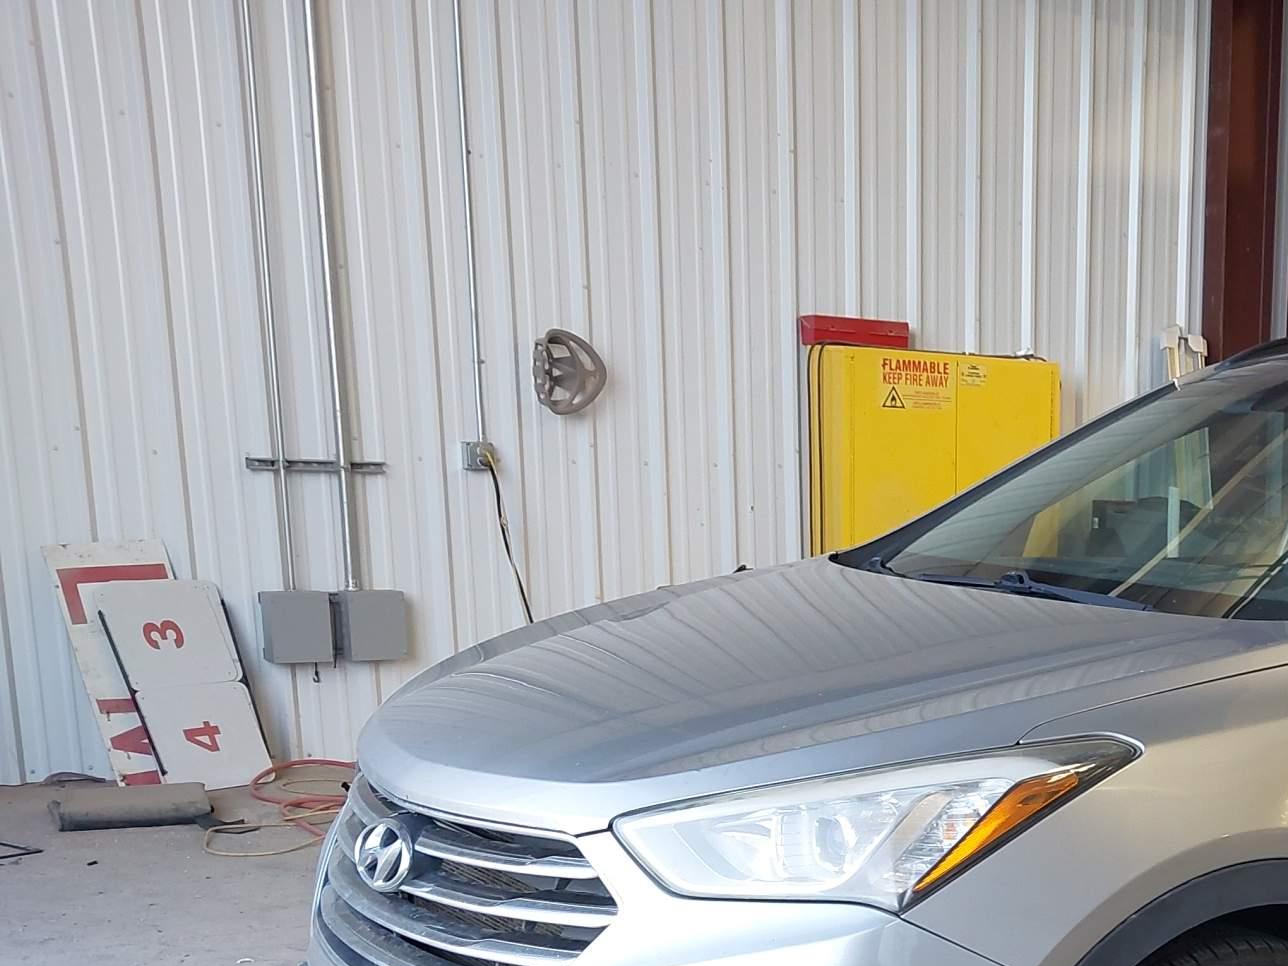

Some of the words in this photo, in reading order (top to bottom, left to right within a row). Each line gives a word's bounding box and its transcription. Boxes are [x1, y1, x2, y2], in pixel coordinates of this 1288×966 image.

[882, 358, 950, 375] FLAMMABLE
[883, 372, 903, 385] KEEP
[905, 373, 923, 387] FIRE
[925, 374, 949, 388] AWAY
[142, 620, 185, 650] 3
[183, 721, 221, 752] 4
